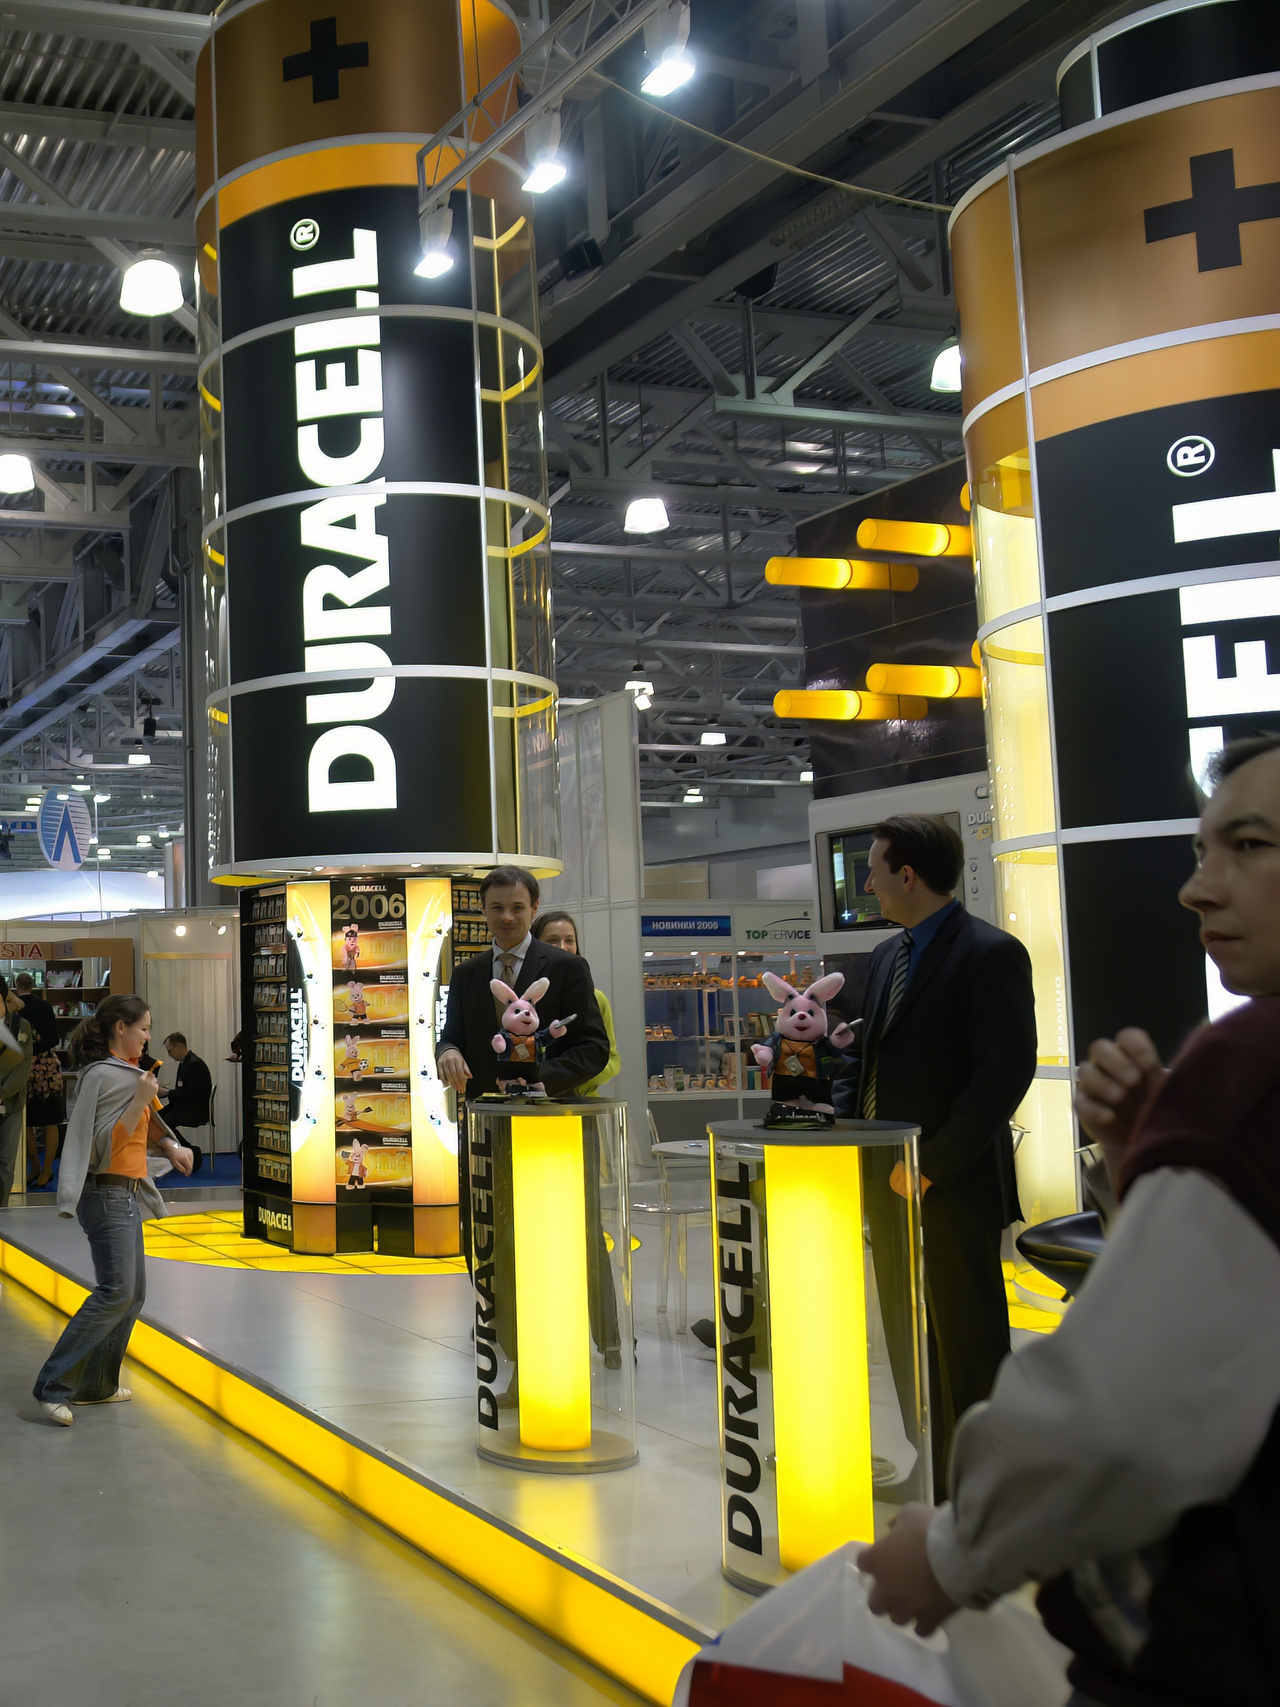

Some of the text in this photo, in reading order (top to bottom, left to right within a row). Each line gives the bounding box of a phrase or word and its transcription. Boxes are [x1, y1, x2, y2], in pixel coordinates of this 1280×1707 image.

[292, 227, 399, 814] DURACELL
[332, 893, 405, 919] 2006
[652, 921, 696, 930] НОВИНКИ
[291, 990, 302, 1082] DURACELL
[258, 1206, 292, 1231] DURACEL
[471, 1127, 500, 1432] DURACELL
[716, 1162, 763, 1556] DURACELL
